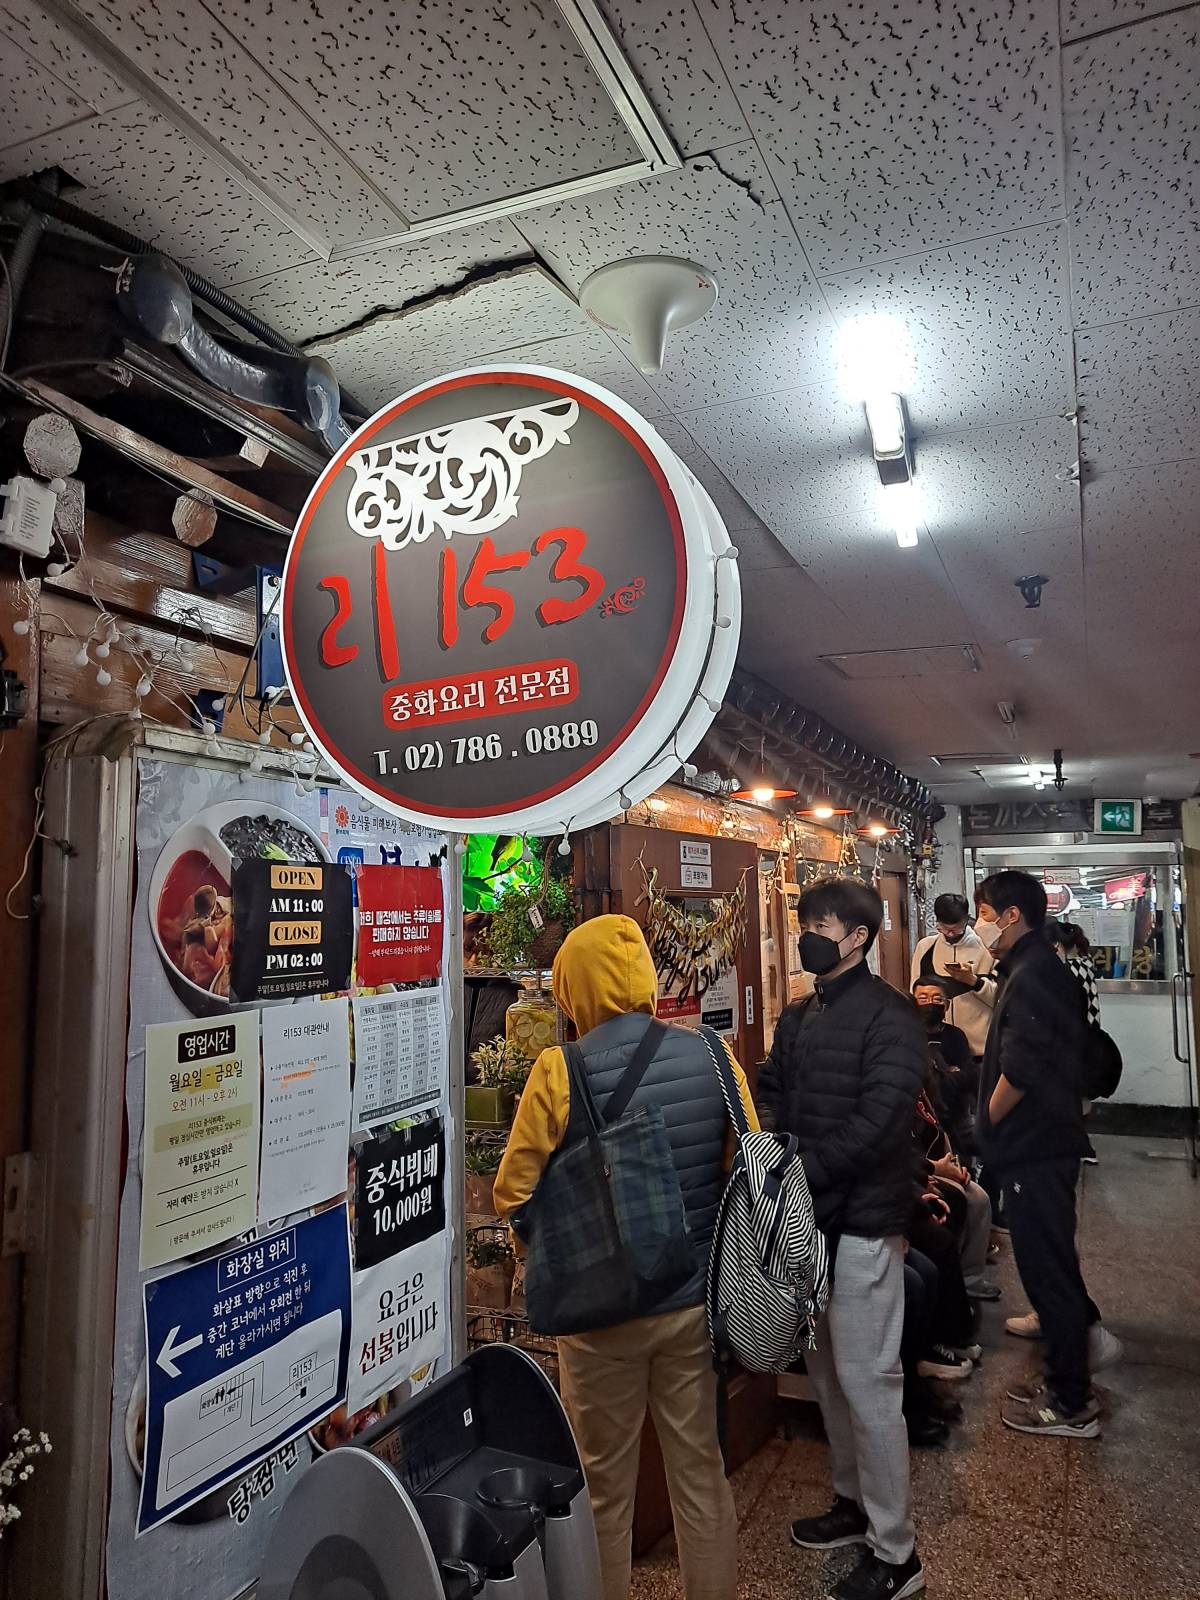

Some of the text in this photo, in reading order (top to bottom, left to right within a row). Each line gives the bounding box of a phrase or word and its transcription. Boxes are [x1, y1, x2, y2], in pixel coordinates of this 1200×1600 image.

[389, 667, 570, 722] 중화요리 전문점
[373, 750, 398, 774] T.
[405, 739, 443, 771] 02)
[452, 733, 502, 764] 786
[525, 720, 599, 754] 0889
[350, 814, 370, 831] 음식물
[278, 870, 316, 885] OPEN
[269, 899, 324, 913] AM 11:00
[376, 910, 411, 925] 매장에서는
[274, 926, 319, 941] CLOSE
[372, 926, 429, 942] 판매하지 않습니다
[266, 953, 323, 970] PM 02:00
[184, 1030, 230, 1057] 영업시간
[283, 1022, 329, 1039] 리153 대관안내
[168, 1068, 202, 1092] 월요일
[215, 1060, 243, 1083] 금요일
[171, 1098, 187, 1112] 오전
[190, 1094, 205, 1107] 11시
[213, 1089, 226, 1102] 오후
[228, 1087, 238, 1098] 2시
[192, 1159, 220, 1174] 휴무입니다
[365, 1143, 438, 1204] 중식뷔페
[166, 1198, 179, 1210] 자리
[180, 1192, 199, 1205] 예약은
[200, 1188, 212, 1199] 받지
[214, 1180, 233, 1195] 않습니다
[372, 1185, 432, 1236] 10,000원
[227, 1237, 289, 1278] 화장실 위치
[212, 1262, 308, 1317] 화살표 방향으로 직진 후
[377, 1271, 425, 1323] 요금은
[207, 1279, 311, 1343] 중간 코너에서 우회전 한 뒤
[215, 1302, 303, 1359] 계단 올라가시면 됩니다
[358, 1300, 438, 1376] 선불입니다
[292, 1359, 313, 1378] 리153
